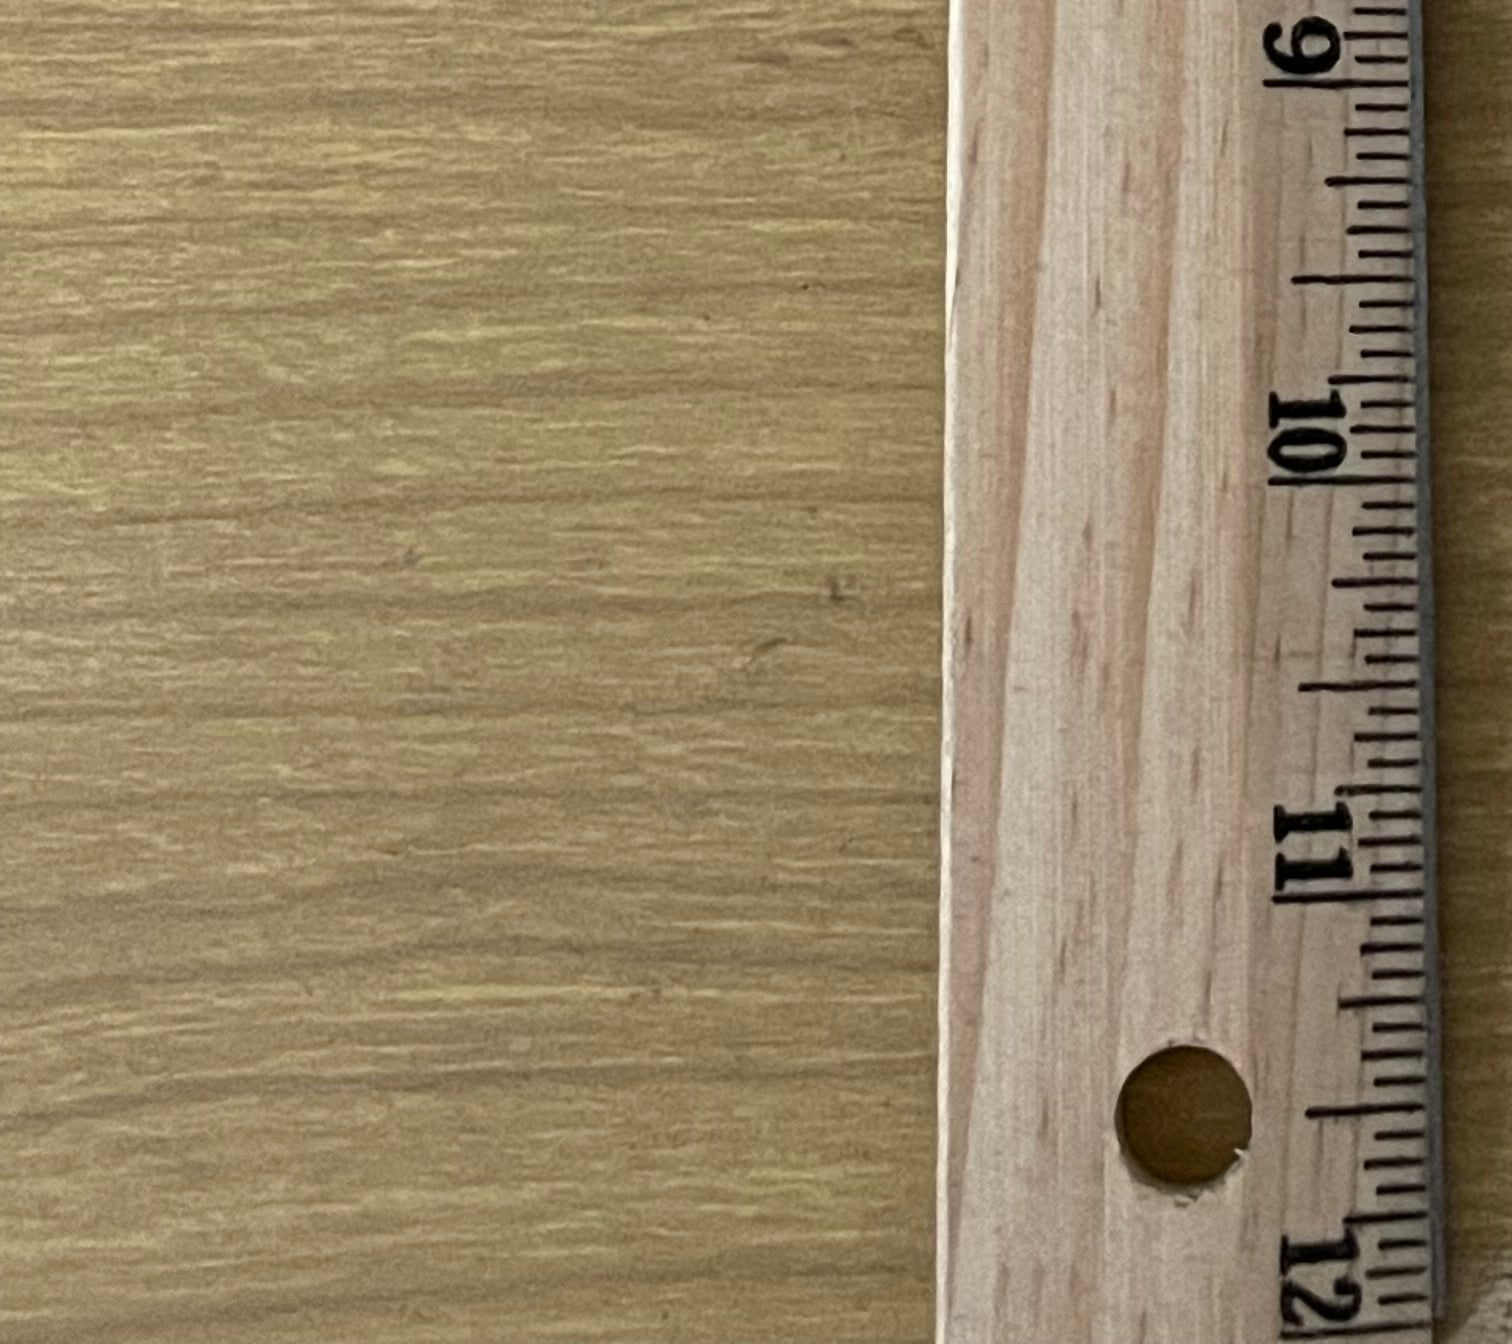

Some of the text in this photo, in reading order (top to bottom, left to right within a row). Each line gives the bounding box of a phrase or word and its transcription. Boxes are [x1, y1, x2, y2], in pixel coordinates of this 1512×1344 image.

[1262, 15, 1342, 76] 9
[1267, 389, 1347, 473] 10
[1273, 801, 1353, 892] 11
[1279, 1233, 1363, 1327] 12
